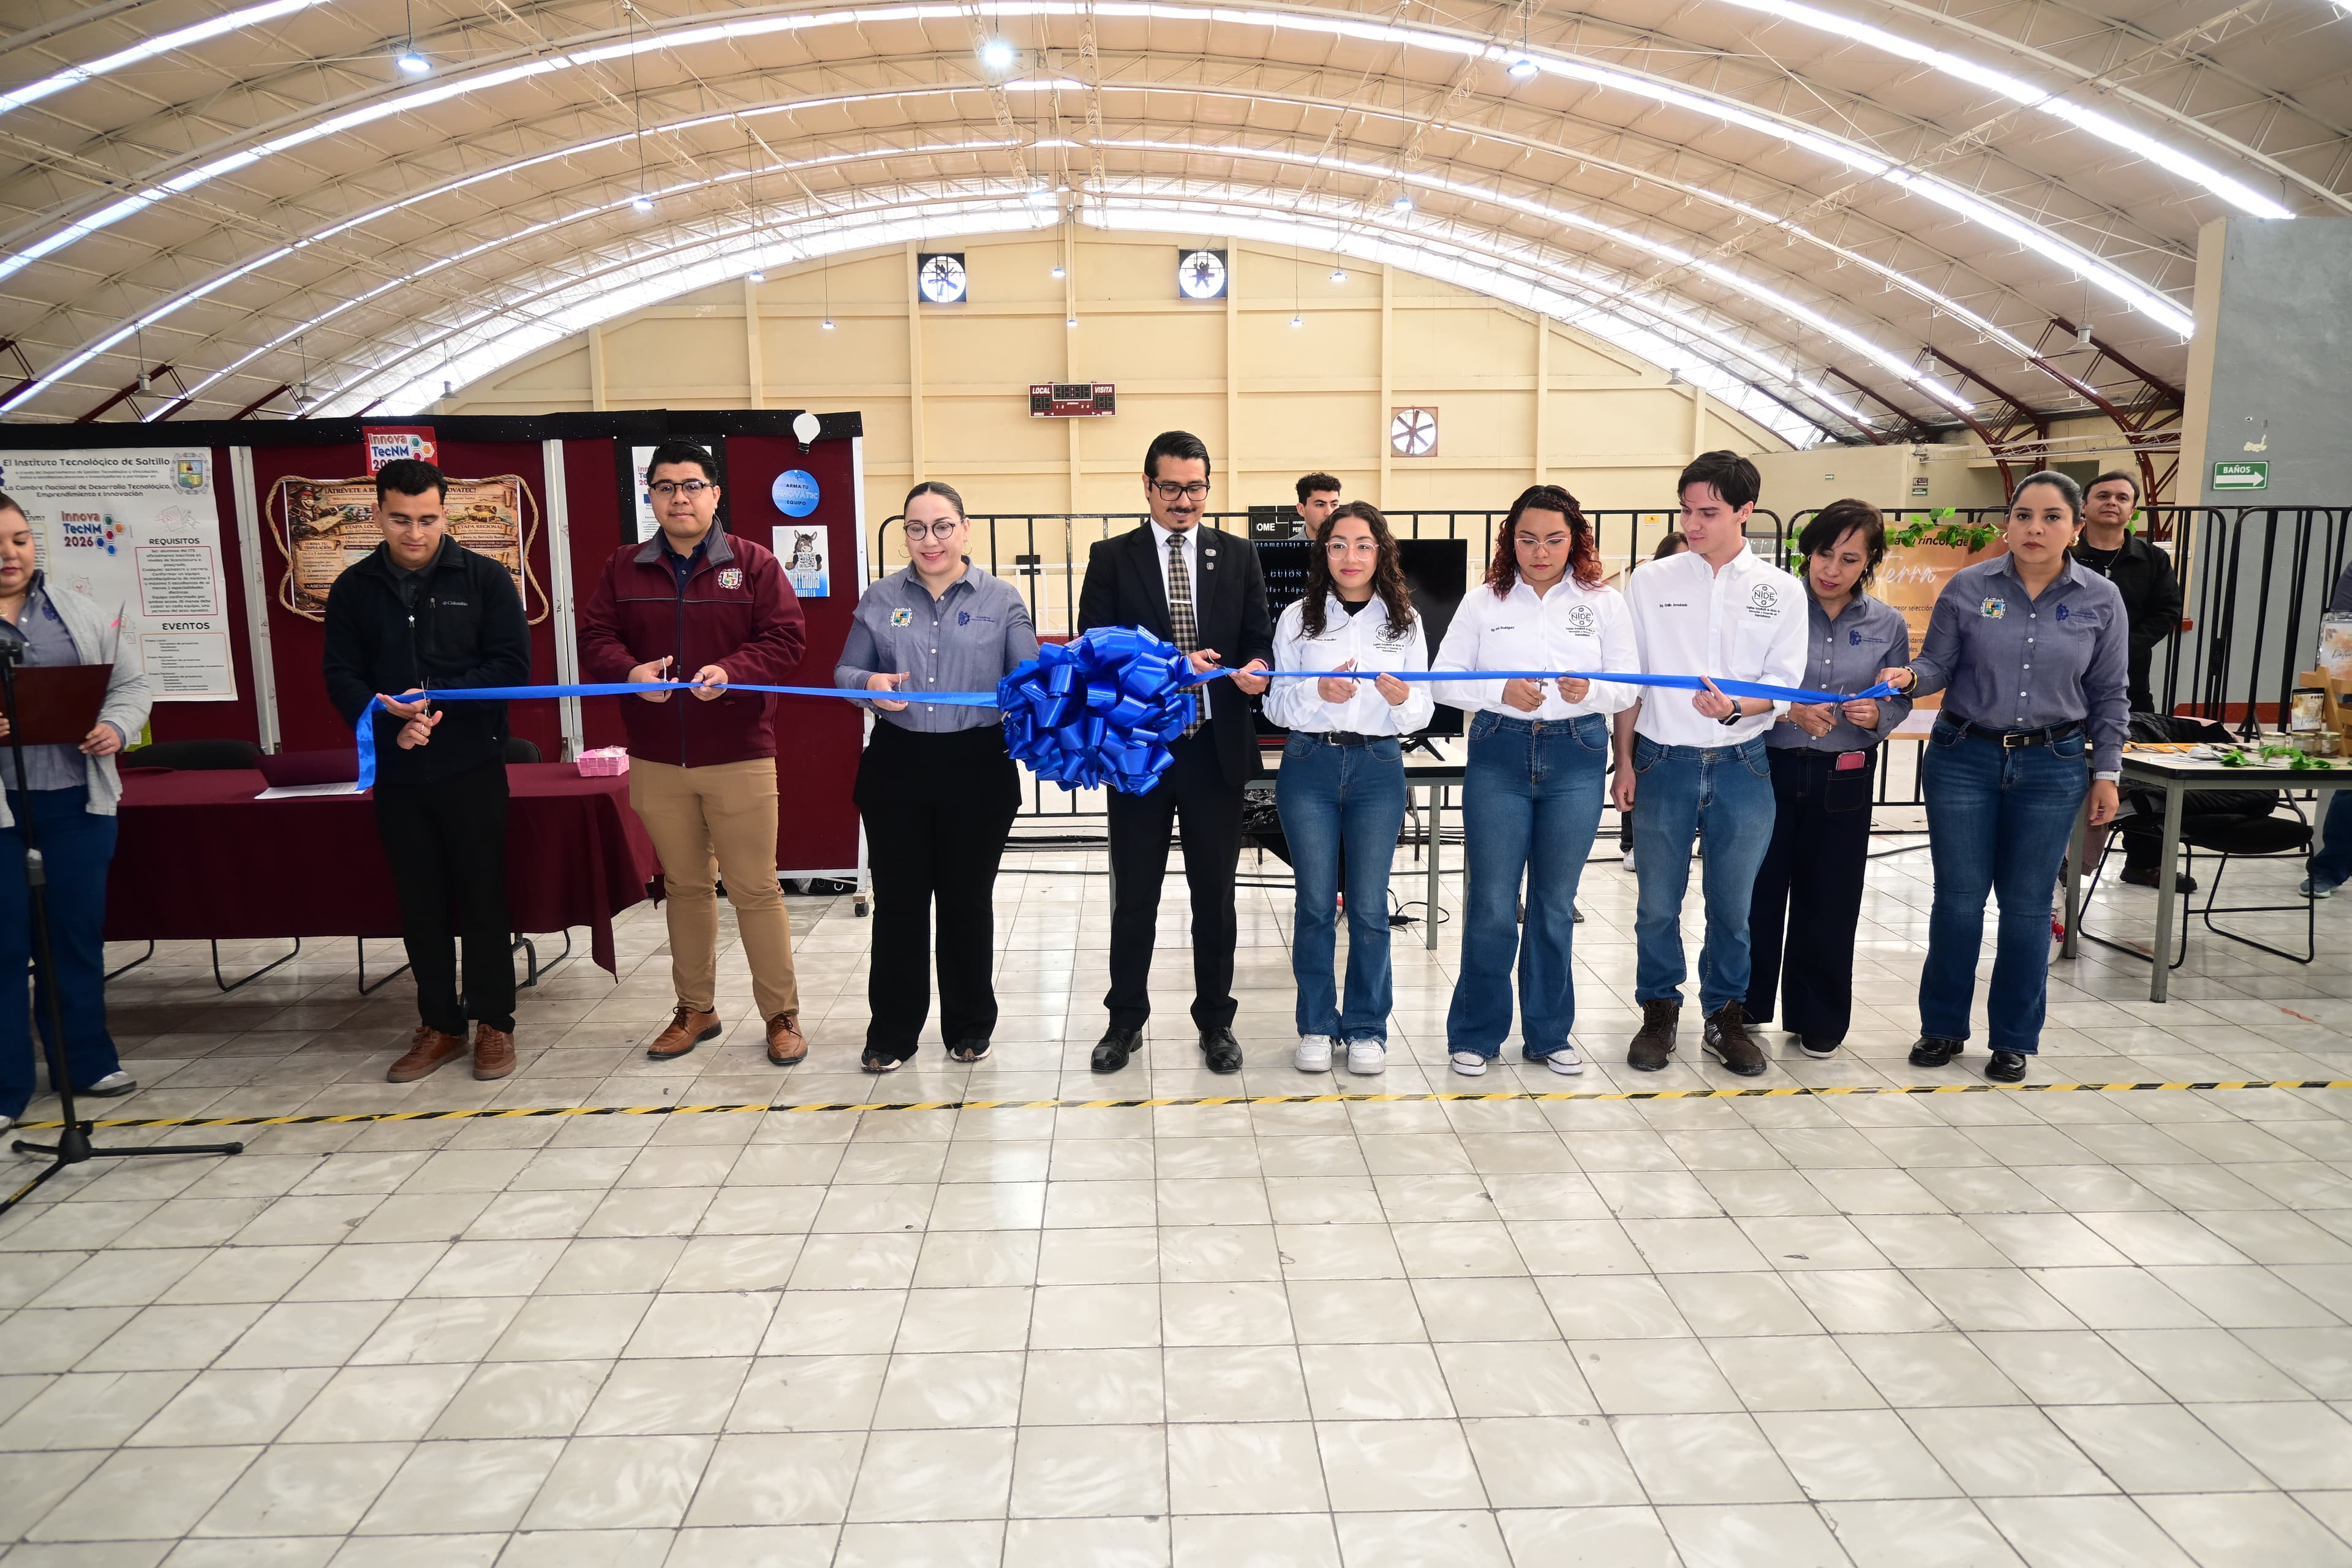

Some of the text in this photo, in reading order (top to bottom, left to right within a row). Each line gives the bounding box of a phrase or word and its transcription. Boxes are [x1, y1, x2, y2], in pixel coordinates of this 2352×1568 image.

[369, 434, 407, 445] Innova
[371, 446, 409, 457] TecNM
[59, 458, 118, 467] Tecnológico
[373, 459, 392, 470] 20
[2223, 464, 2251, 473] BAÑOS
[61, 511, 100, 521] Innova
[63, 523, 102, 534] TecNM
[64, 537, 93, 547] 2026
[1270, 568, 1302, 578] GUIÓN
[788, 572, 820, 589] MATCHDAY
[1754, 590, 1775, 600] NIDE
[1571, 612, 1591, 621] NIDE
